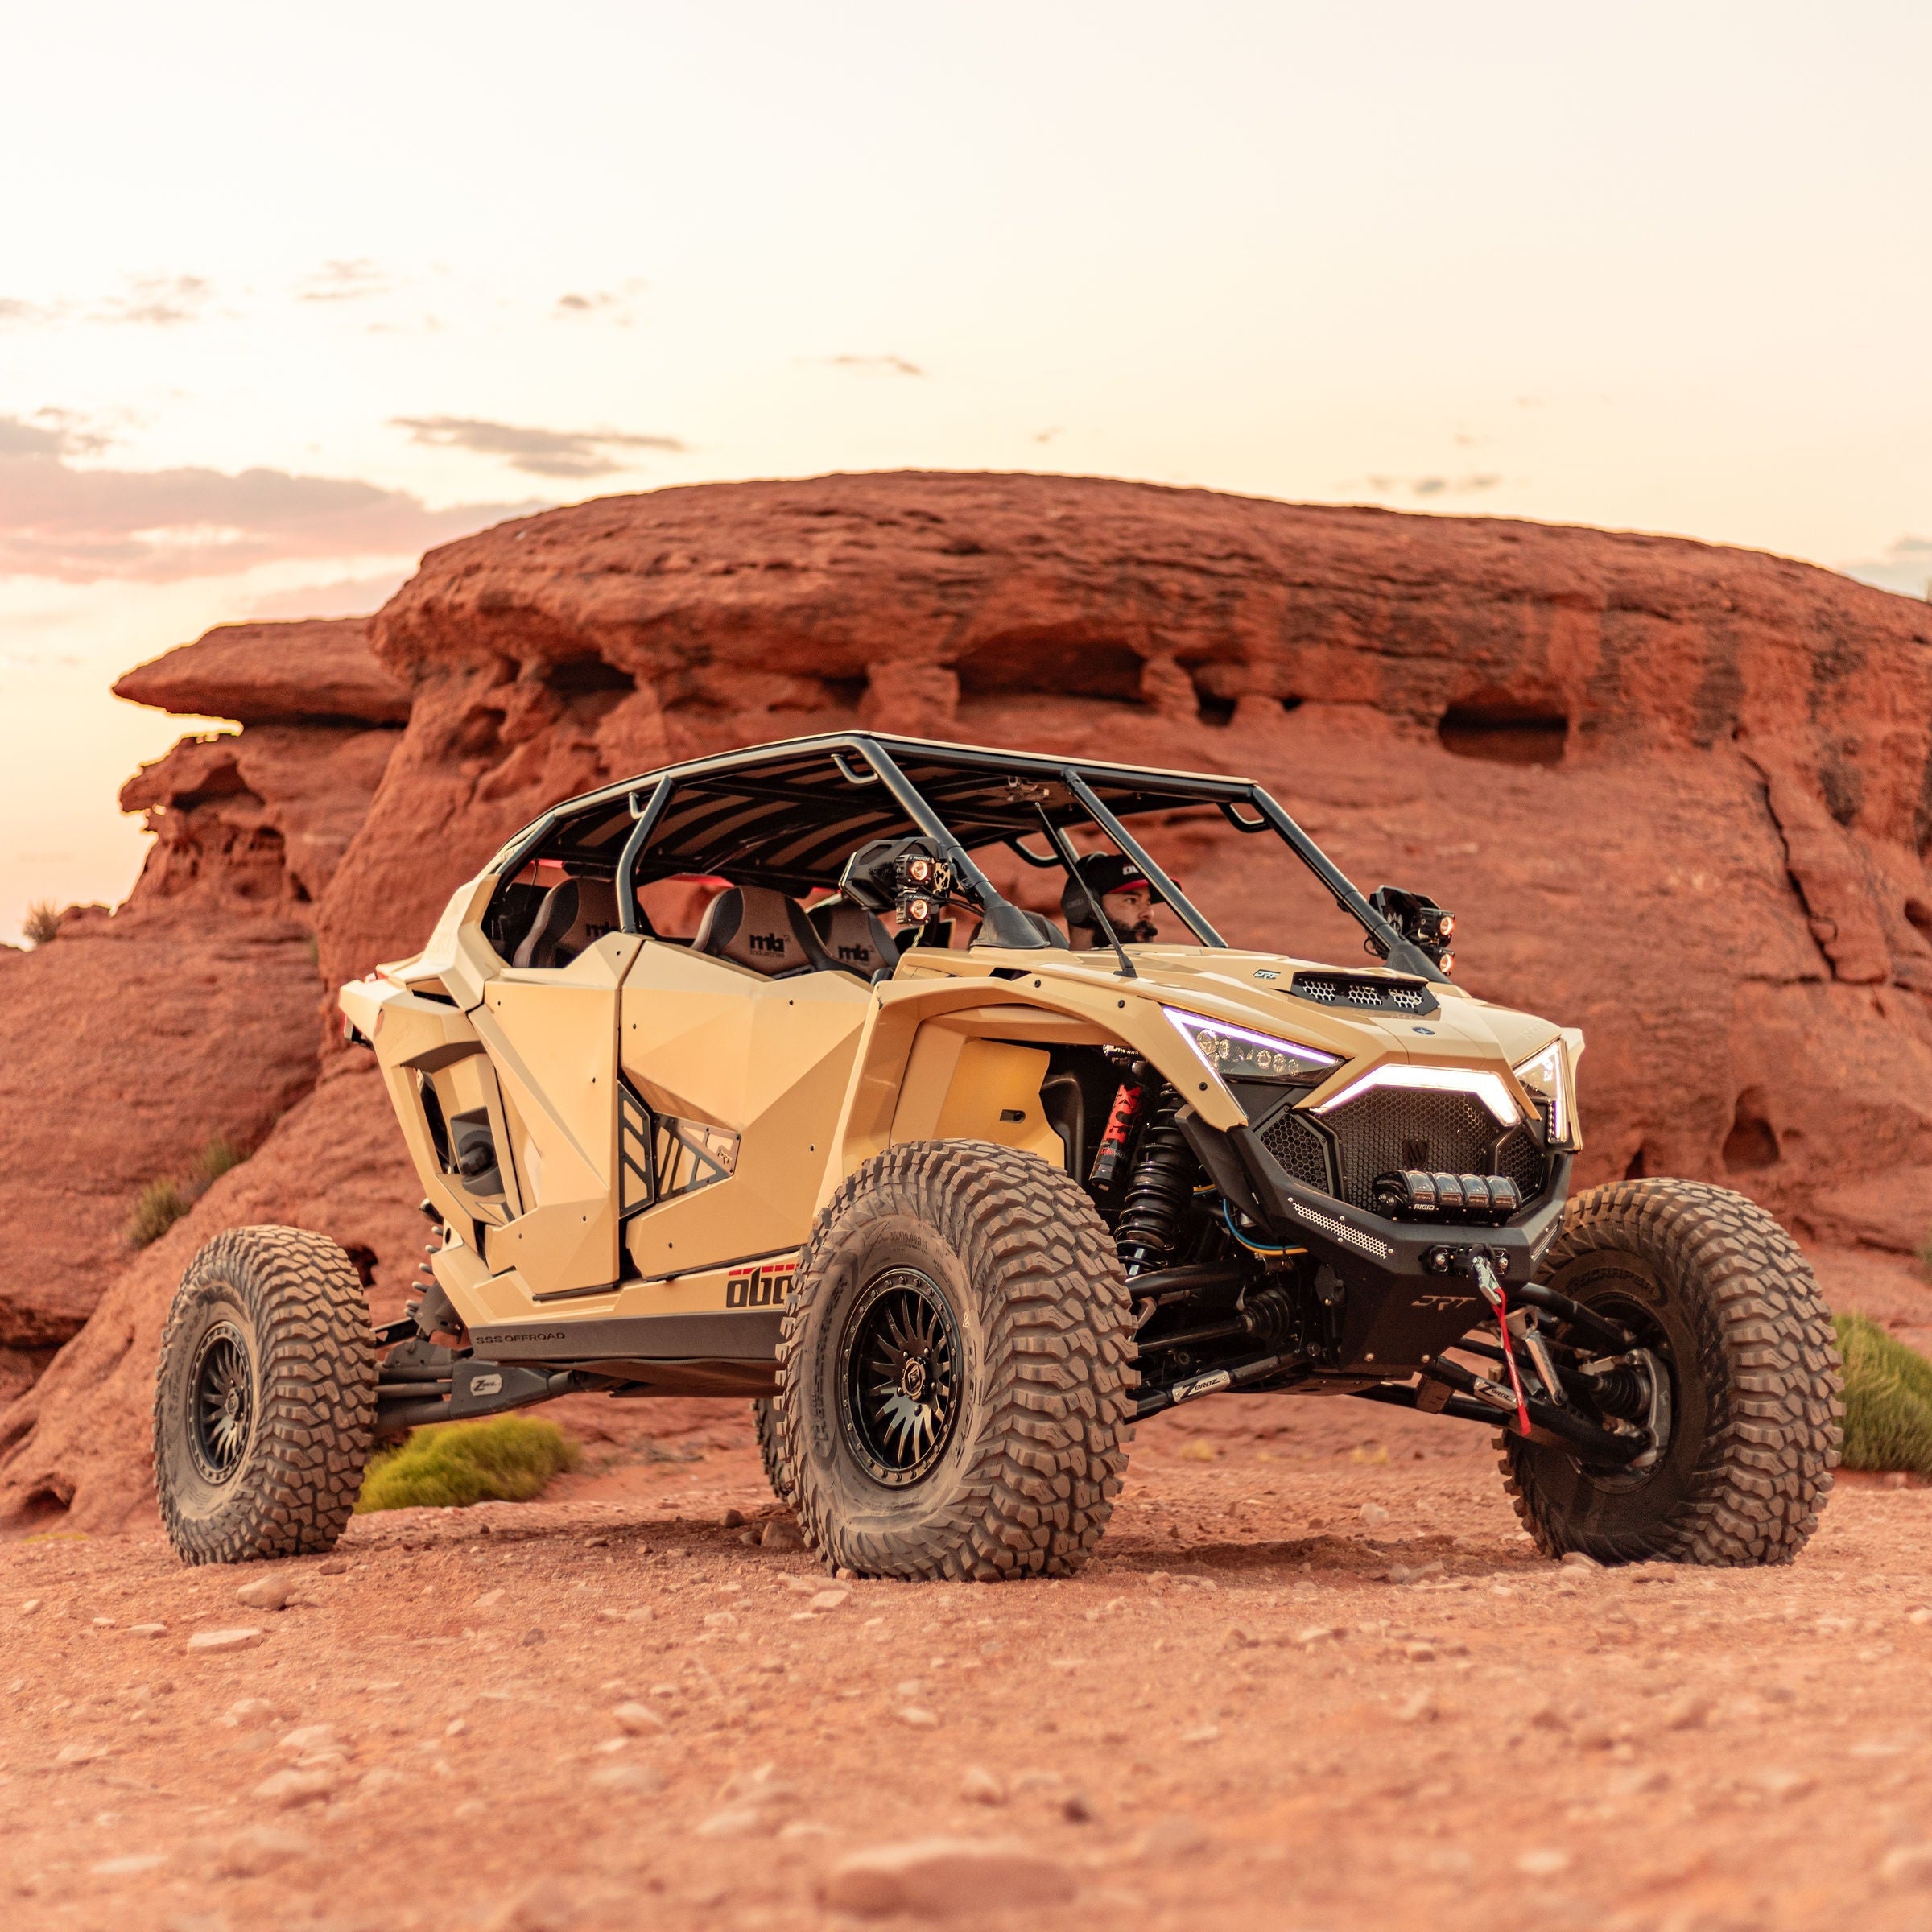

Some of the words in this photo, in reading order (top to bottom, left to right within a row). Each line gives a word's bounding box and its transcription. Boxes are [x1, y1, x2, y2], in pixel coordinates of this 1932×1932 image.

[1102, 1082, 1141, 1143] FOX
[477, 1335, 503, 1344] SSS
[505, 1332, 566, 1343] OFFROAD
[1180, 1378, 1221, 1399] ZBROZ
